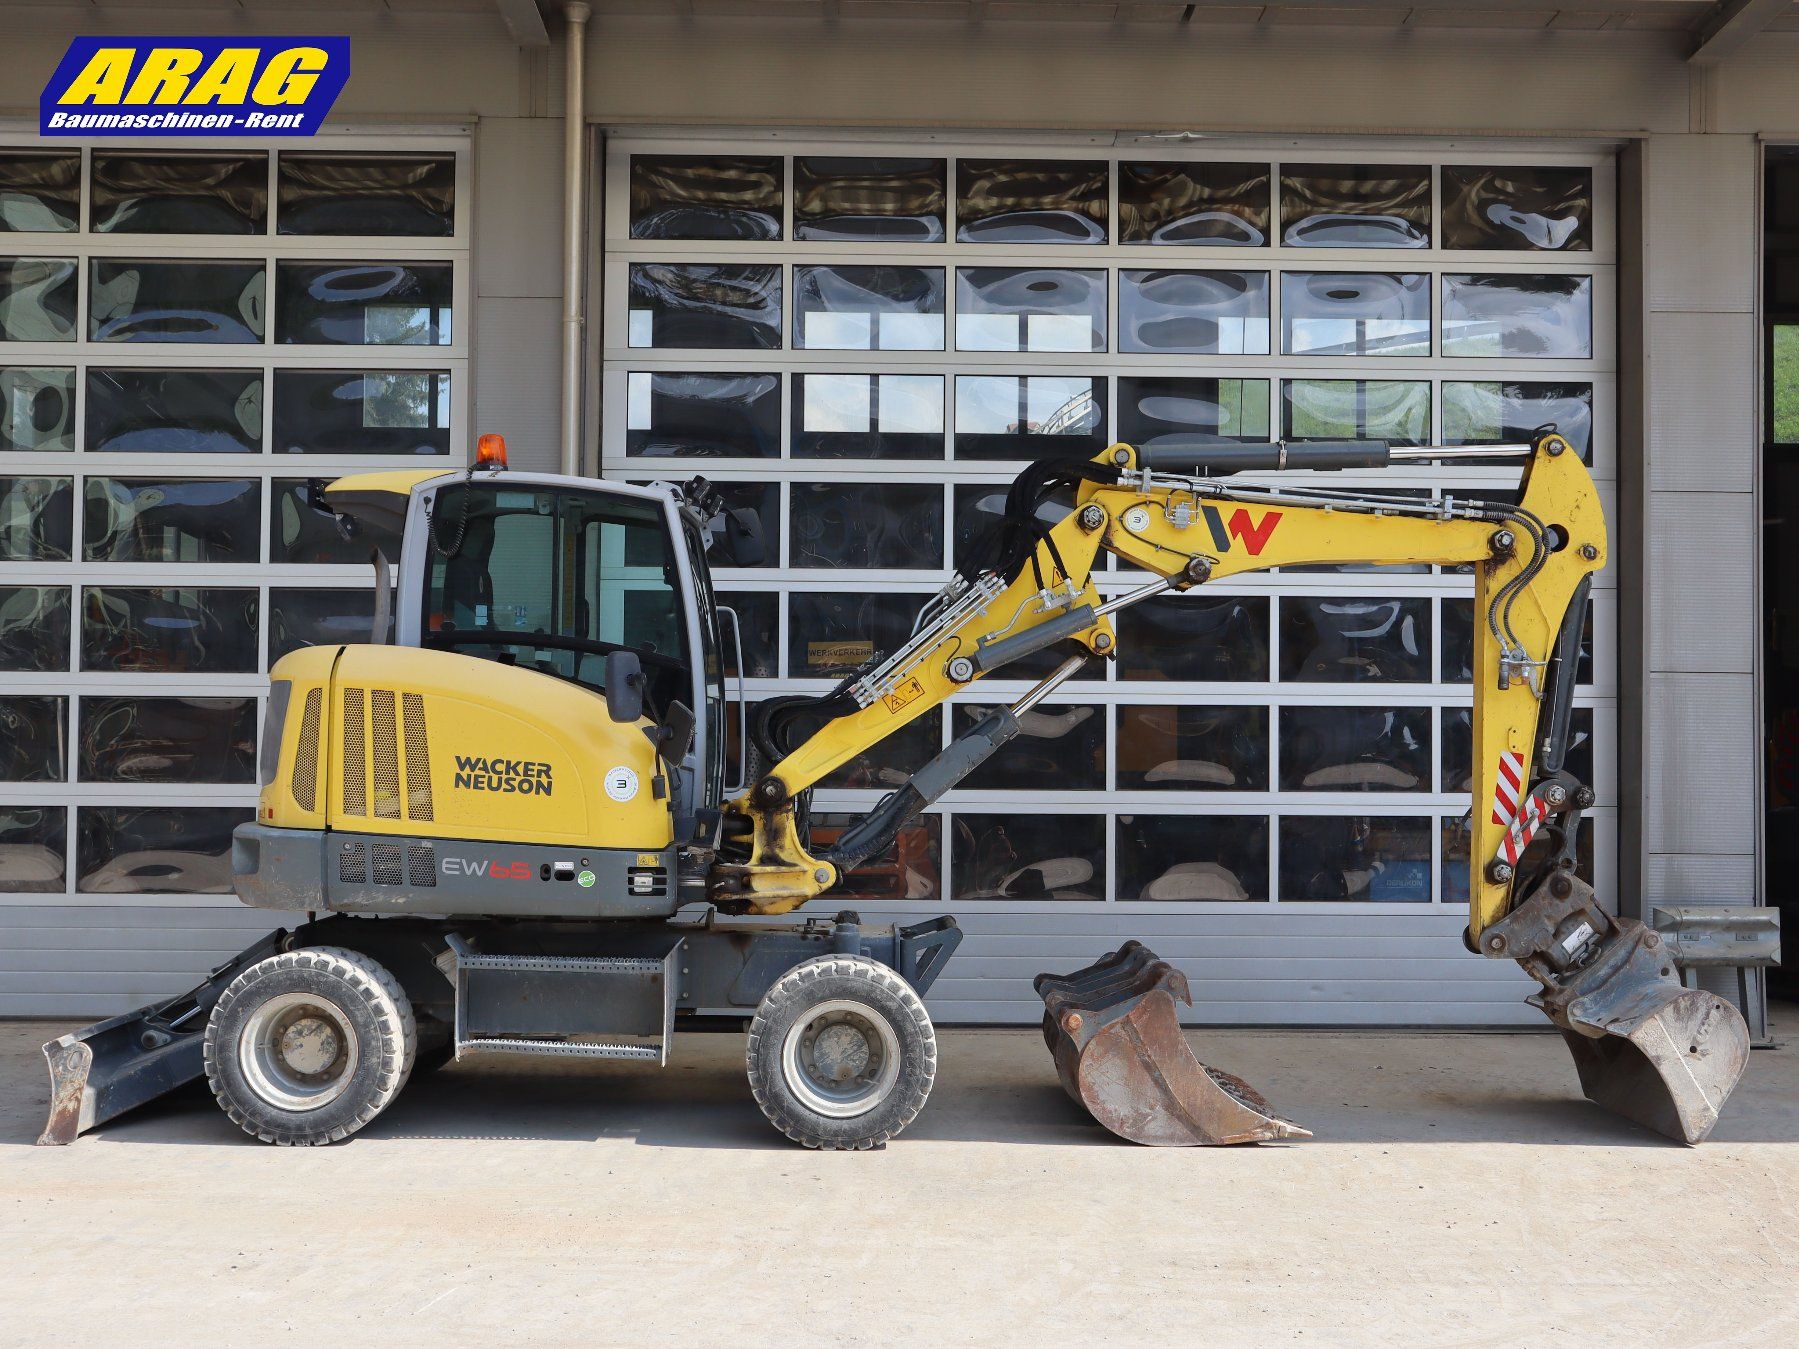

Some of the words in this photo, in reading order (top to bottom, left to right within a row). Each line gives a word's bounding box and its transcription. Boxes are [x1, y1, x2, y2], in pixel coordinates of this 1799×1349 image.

[808, 648, 872, 657] WERKVERKEHR
[455, 755, 553, 779] WACKER
[454, 773, 553, 796] NEUSON
[616, 779, 627, 789] 3
[441, 857, 531, 881] EW65
